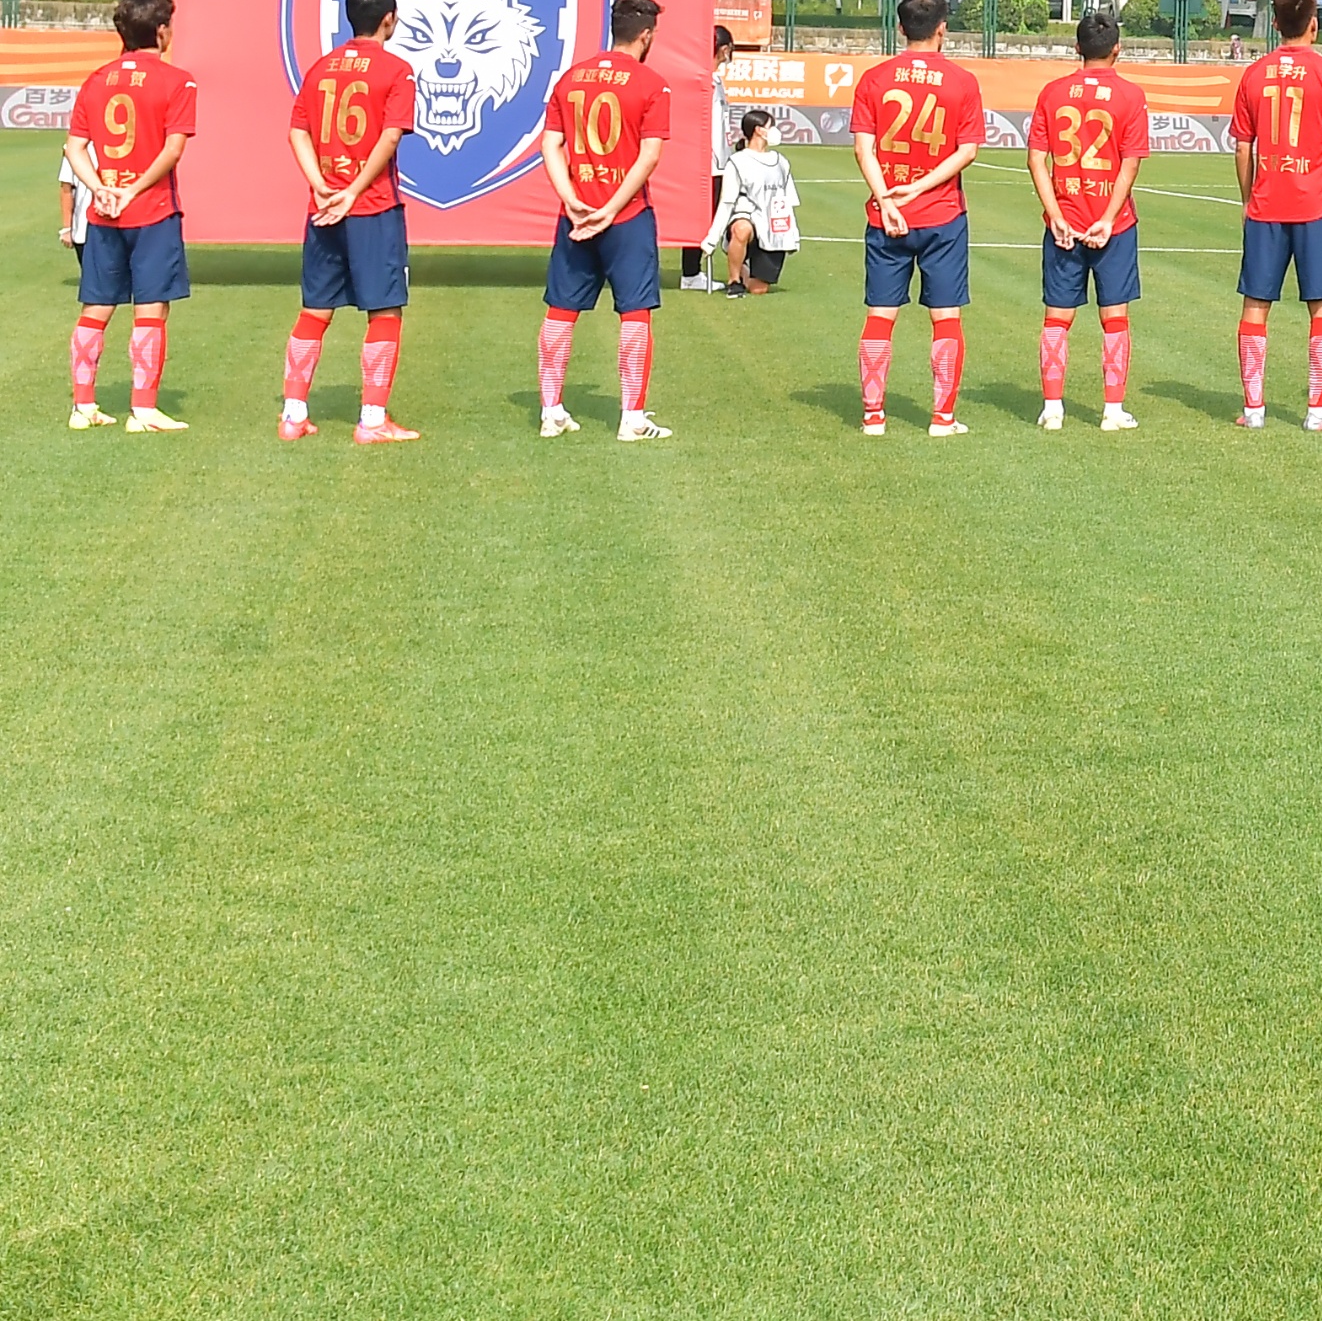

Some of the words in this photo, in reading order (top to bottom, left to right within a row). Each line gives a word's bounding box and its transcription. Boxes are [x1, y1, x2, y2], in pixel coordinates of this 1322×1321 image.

[8, 104, 71, 127] Gan
[25, 89, 75, 104] 百岁
[318, 78, 369, 146] 16
[567, 90, 621, 155] 10
[725, 87, 753, 97] HINA
[754, 87, 804, 98] LEAGUE
[880, 88, 946, 157] 24
[1153, 116, 1190, 130] 岁山
[1263, 85, 1304, 147] 11
[104, 93, 136, 159] 9
[1054, 105, 1113, 170] 32
[1149, 131, 1211, 151] anten
